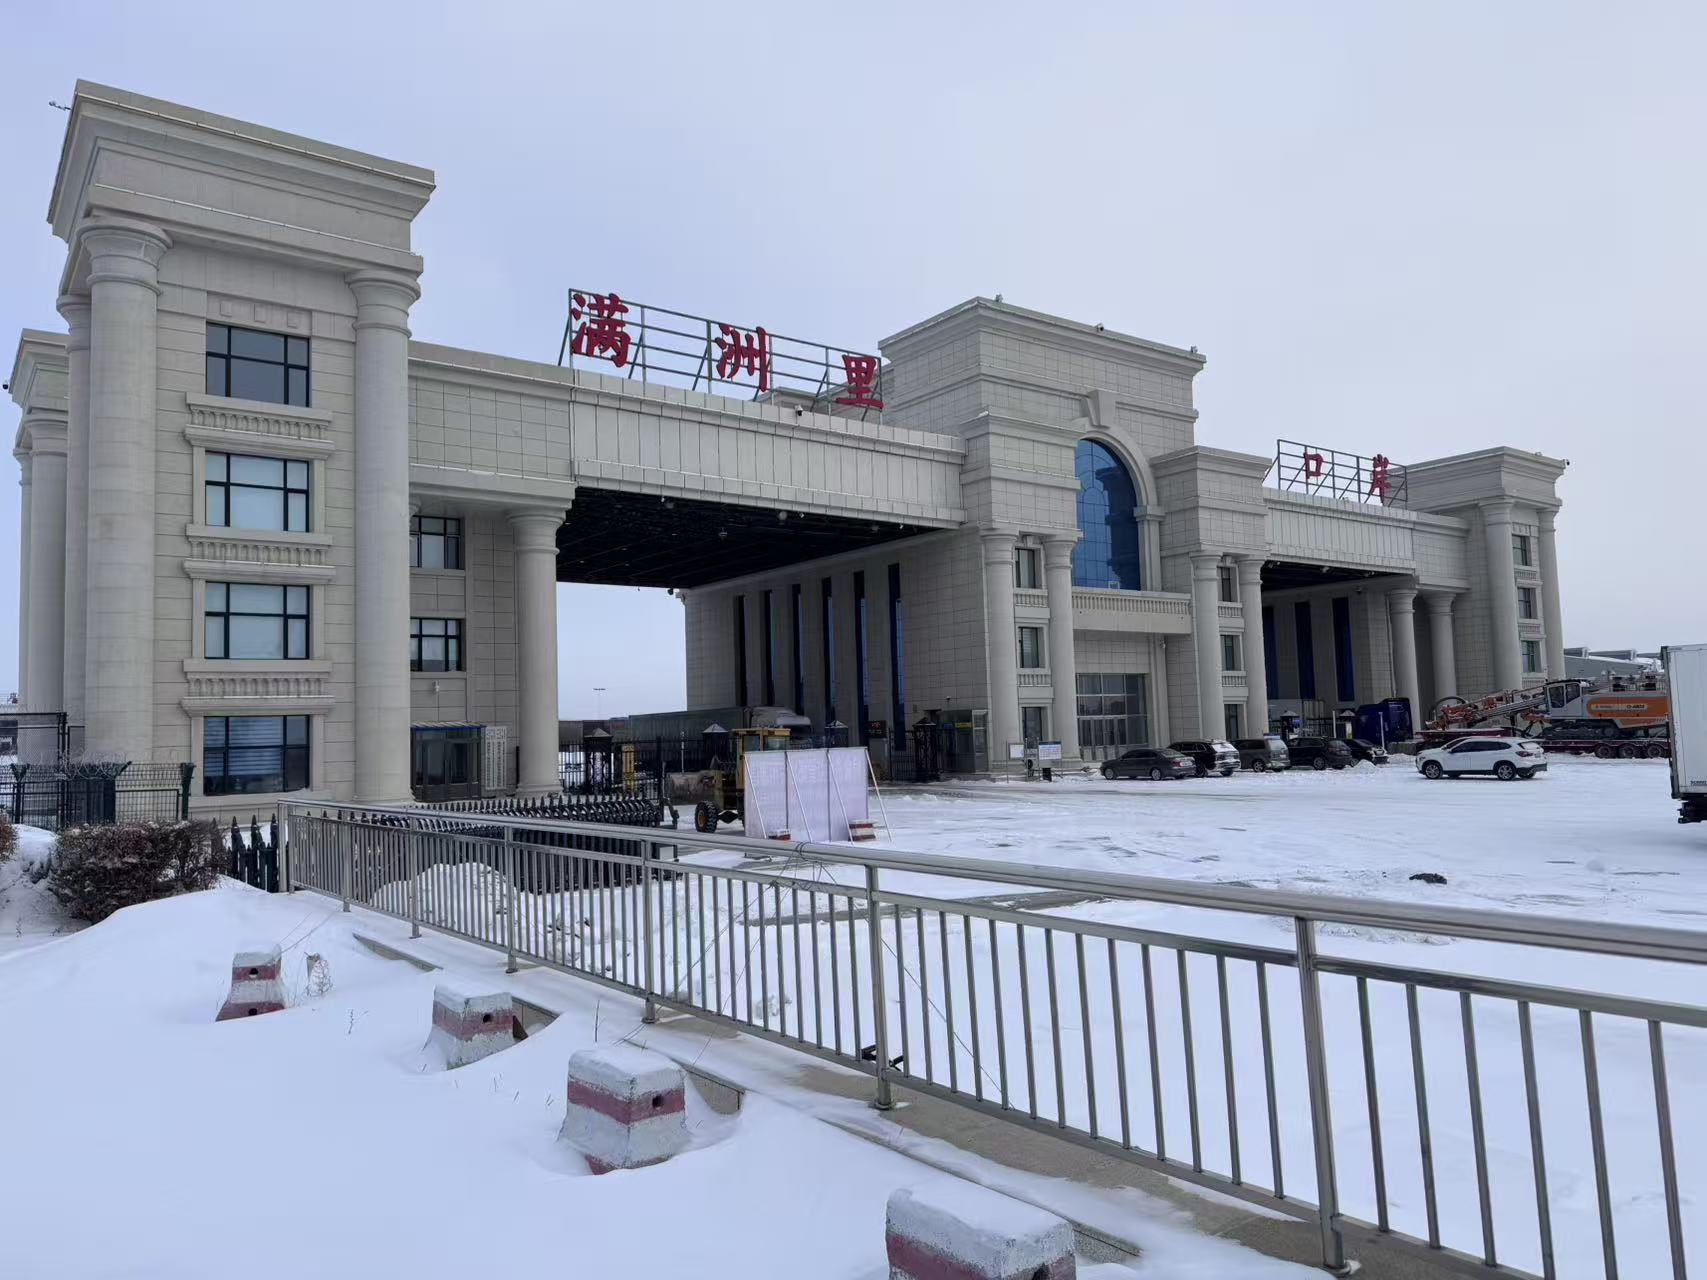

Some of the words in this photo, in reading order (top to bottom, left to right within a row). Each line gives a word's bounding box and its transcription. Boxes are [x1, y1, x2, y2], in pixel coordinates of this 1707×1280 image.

[571, 293, 884, 409] 满洲里
[1303, 452, 1392, 506] 口岸
